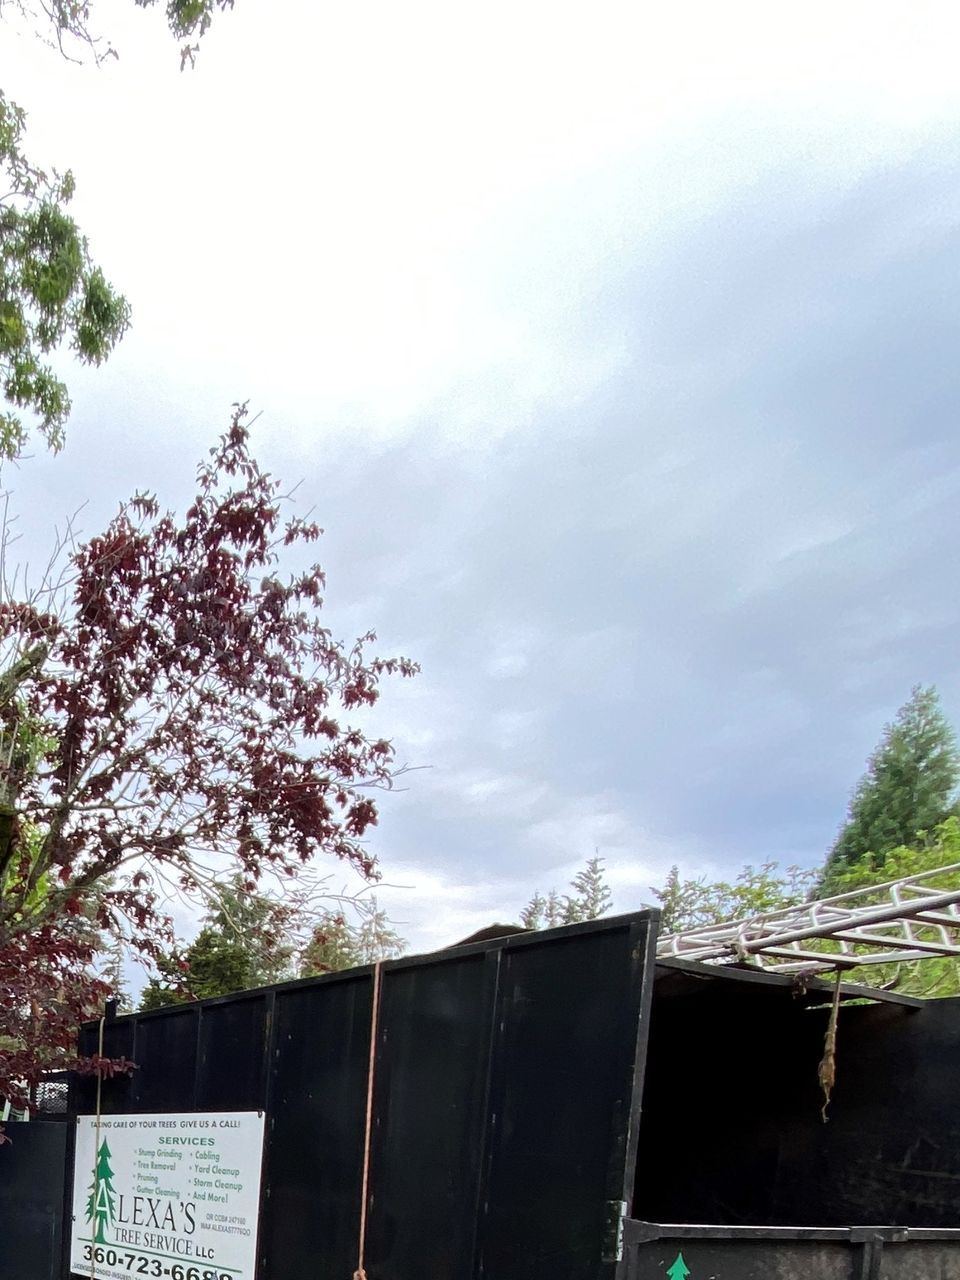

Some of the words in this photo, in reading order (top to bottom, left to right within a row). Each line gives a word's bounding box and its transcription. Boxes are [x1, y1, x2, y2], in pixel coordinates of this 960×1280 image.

[90, 1121, 112, 1129] TAING
[113, 1121, 128, 1129] CARE
[129, 1121, 137, 1129] OF
[139, 1121, 157, 1129] YOUR
[158, 1120, 177, 1129] TREES
[180, 1120, 197, 1129] GIVE
[199, 1120, 209, 1128] US
[211, 1120, 217, 1128] A
[219, 1120, 241, 1129] CALL!
[158, 1136, 216, 1147] SERVICES
[138, 1148, 156, 1158] Stump
[156, 1149, 182, 1161] Grinding
[195, 1150, 220, 1162] Cabling
[138, 1160, 149, 1169] Tree
[150, 1161, 176, 1171] Removal
[195, 1164, 210, 1174] Yard
[211, 1165, 240, 1178] Cleanup
[137, 1173, 159, 1184] Pruning
[193, 1177, 213, 1188] Storm
[214, 1179, 243, 1192] Cleanup
[136, 1185, 154, 1194] Gutter
[193, 1191, 206, 1201] And
[207, 1193, 228, 1203] More!
[94, 1180, 196, 1235] ALEXA'S
[114, 1227, 141, 1246] TREE
[143, 1232, 192, 1256] SERVICE
[195, 1246, 215, 1259] LLC
